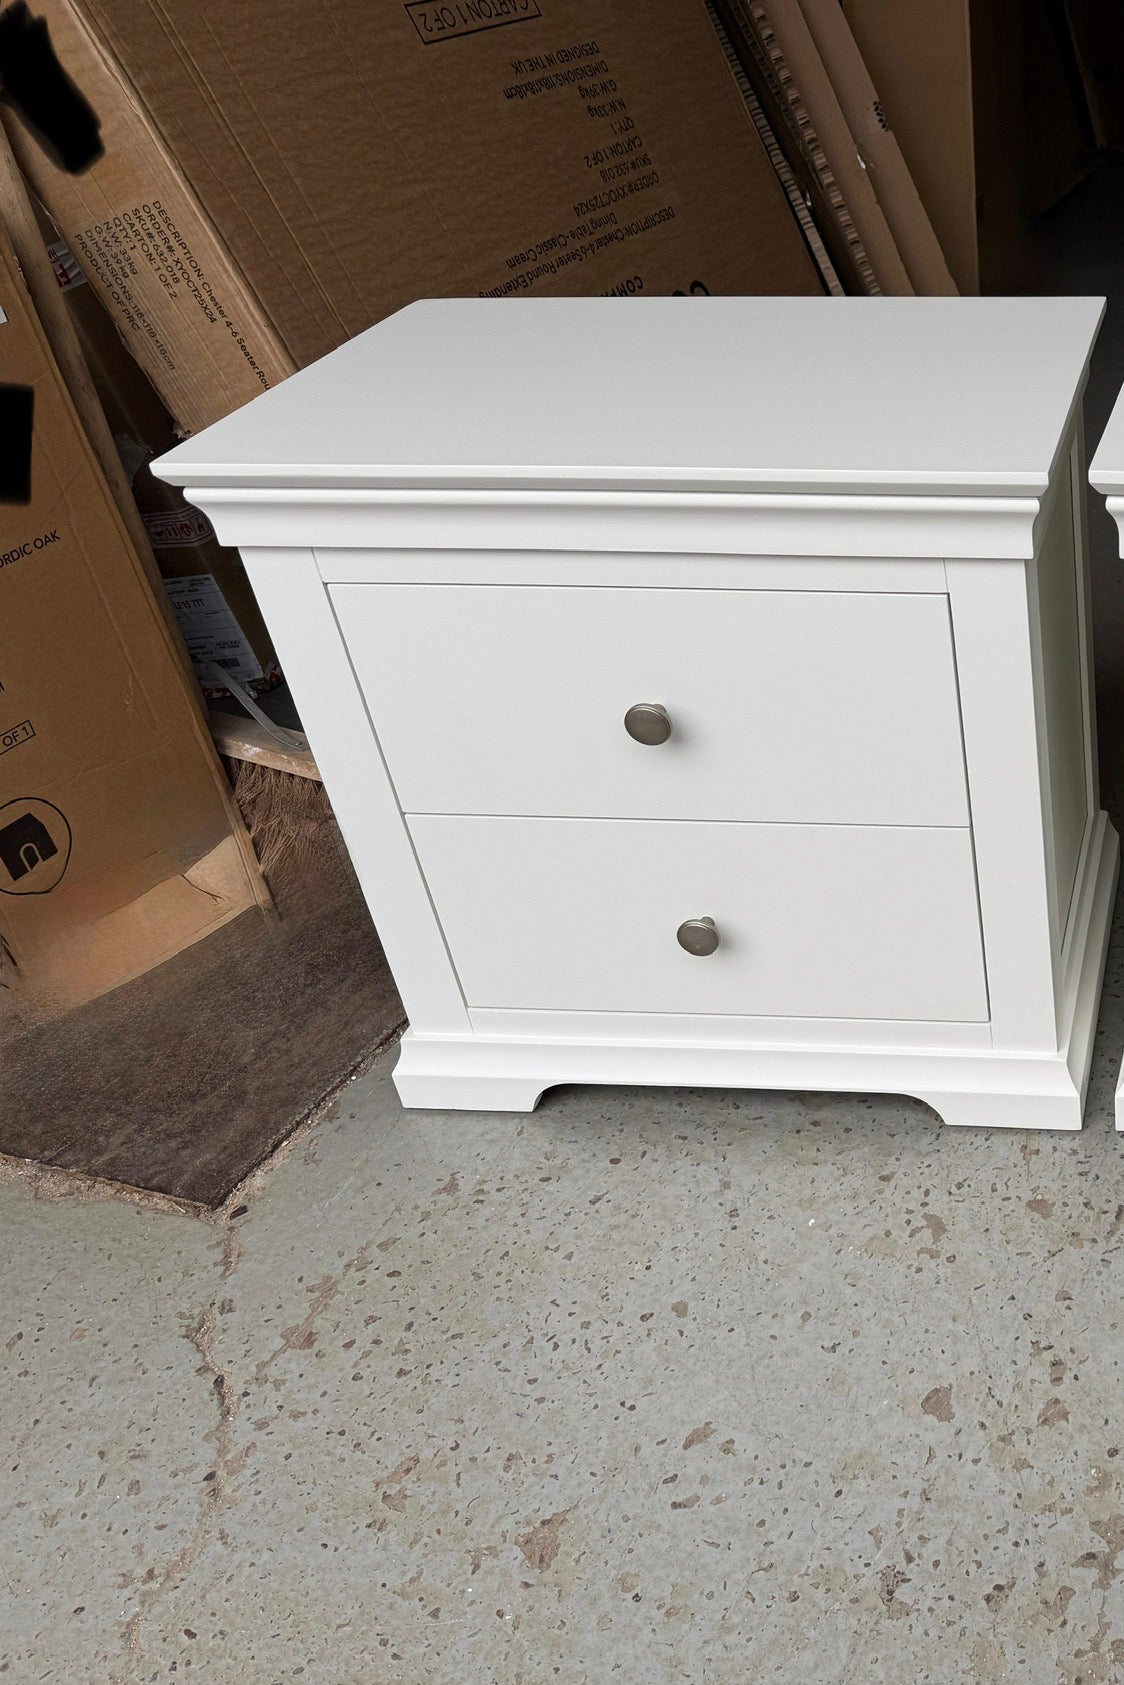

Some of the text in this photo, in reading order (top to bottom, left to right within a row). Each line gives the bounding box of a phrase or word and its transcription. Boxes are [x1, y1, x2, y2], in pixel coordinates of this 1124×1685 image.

[418, 13, 434, 33] 2
[434, 7, 457, 31] OF
[512, 41, 600, 76] DESIGNED IN THE UK
[584, 156, 593, 168] 2
[592, 150, 604, 166] OF
[113, 217, 132, 246] QTY:
[571, 223, 595, 240] Table
[590, 212, 618, 230] Dining
[103, 221, 122, 247] N.W:
[132, 208, 180, 284] SKU#: 632.018
[122, 213, 156, 266] CARTON:
[159, 273, 173, 290] OF
[169, 291, 178, 300] 2
[506, 248, 538, 270] Cream
[556, 247, 584, 269] Seater
[582, 240, 600, 257] 4-6
[84, 229, 133, 304] DIMENSIONS:
[142, 204, 217, 324] ORDER#: XYOCT25X24
[527, 258, 558, 282] Round
[74, 234, 141, 332] PRODUCT OF PRC
[153, 200, 204, 281] DESCRIPTION:
[202, 281, 228, 320] Chester
[224, 320, 238, 338] 4-6
[236, 338, 259, 372] Seater
[33, 530, 61, 550] OAK
[2, 726, 29, 748] OF 1
